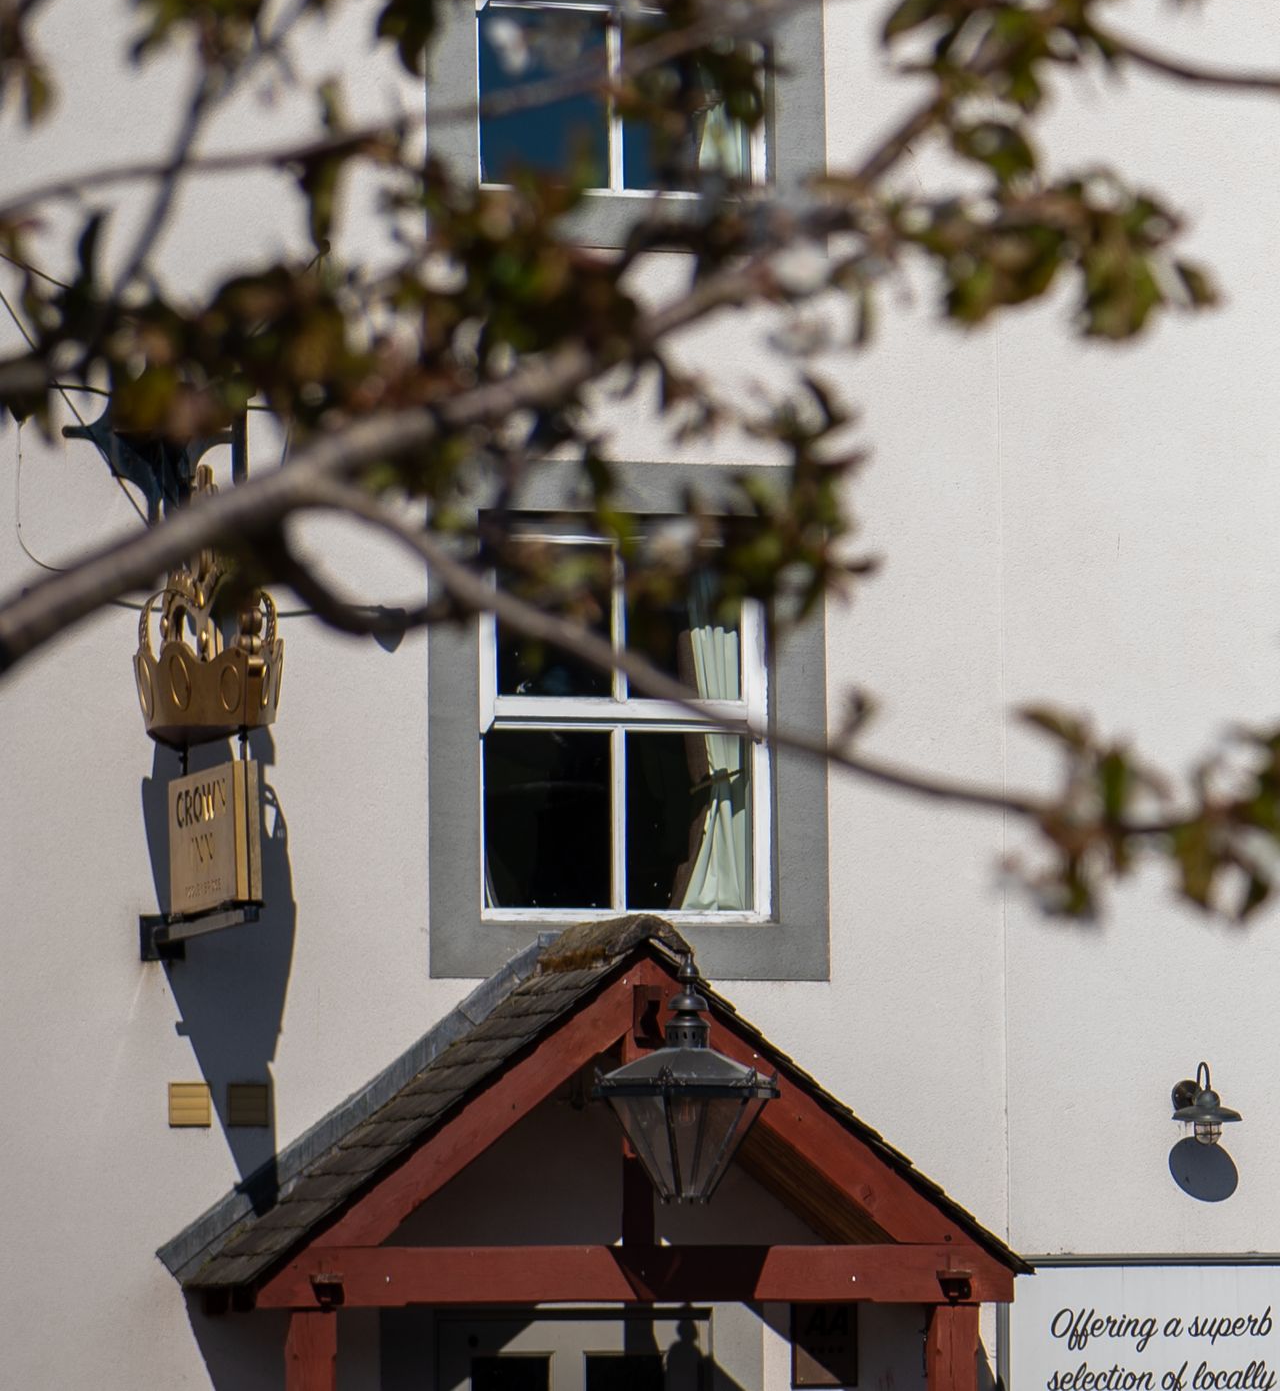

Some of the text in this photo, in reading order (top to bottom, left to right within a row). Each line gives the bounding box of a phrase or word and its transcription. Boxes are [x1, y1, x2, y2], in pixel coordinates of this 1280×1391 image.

[1050, 1305, 1273, 1353] Offering a superb
[1047, 1361, 1157, 1391] selection
[1160, 1360, 1188, 1391] of
